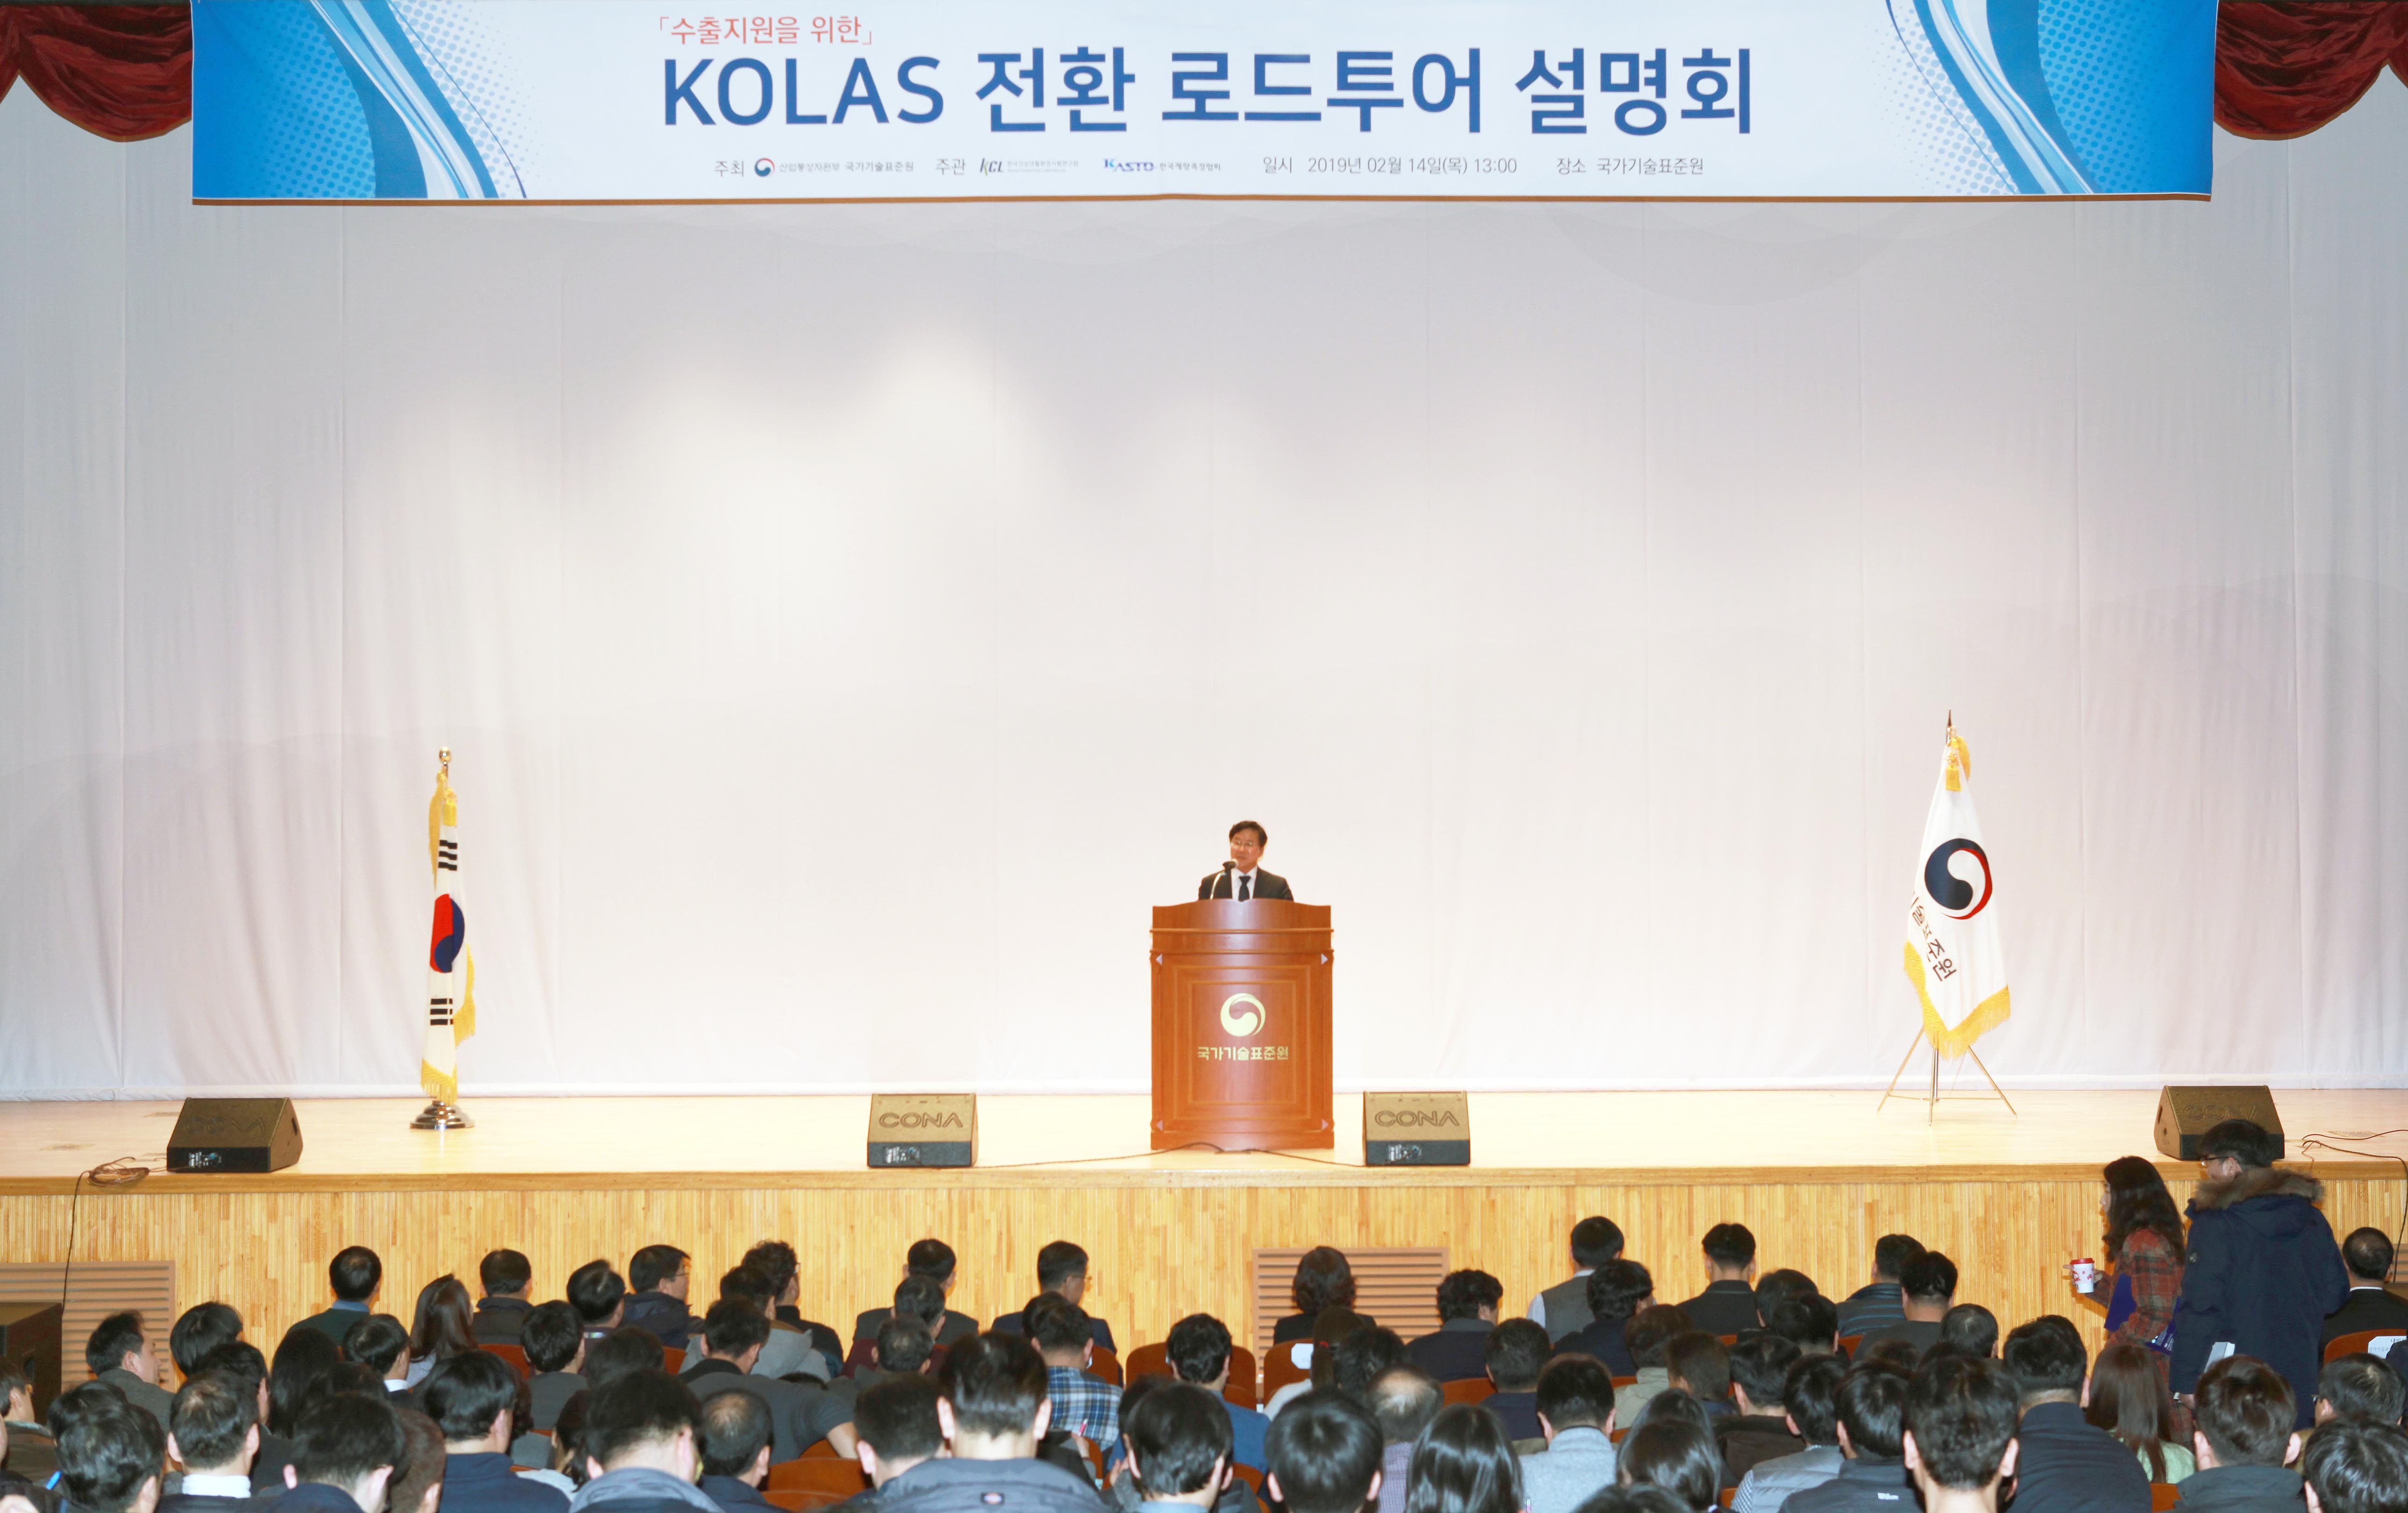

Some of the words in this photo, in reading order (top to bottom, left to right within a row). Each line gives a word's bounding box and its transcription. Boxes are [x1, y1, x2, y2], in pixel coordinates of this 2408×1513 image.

[664, 56, 944, 126] KOLAS
[975, 46, 1136, 133] 전환
[1162, 47, 1481, 133] 로드투어
[1514, 47, 1750, 136] 설명회
[714, 160, 744, 177] 주최
[845, 161, 914, 172] 국가기술표준원
[935, 158, 966, 175] 주관
[980, 158, 1003, 176] KCL
[1104, 159, 1154, 172] KASTO
[1263, 157, 1292, 174] 일시
[1308, 157, 1361, 174] 2019년
[1367, 157, 1401, 175] 02월
[1409, 157, 1468, 175] 14일(목)
[1474, 157, 1517, 173] 13:00
[1556, 157, 1587, 175] 장소
[1597, 157, 1703, 175] 국가기술표준원
[1198, 1046, 1289, 1061] 국가기술표준원
[879, 1112, 963, 1128] CONA
[1375, 1110, 1460, 1127] CONA
